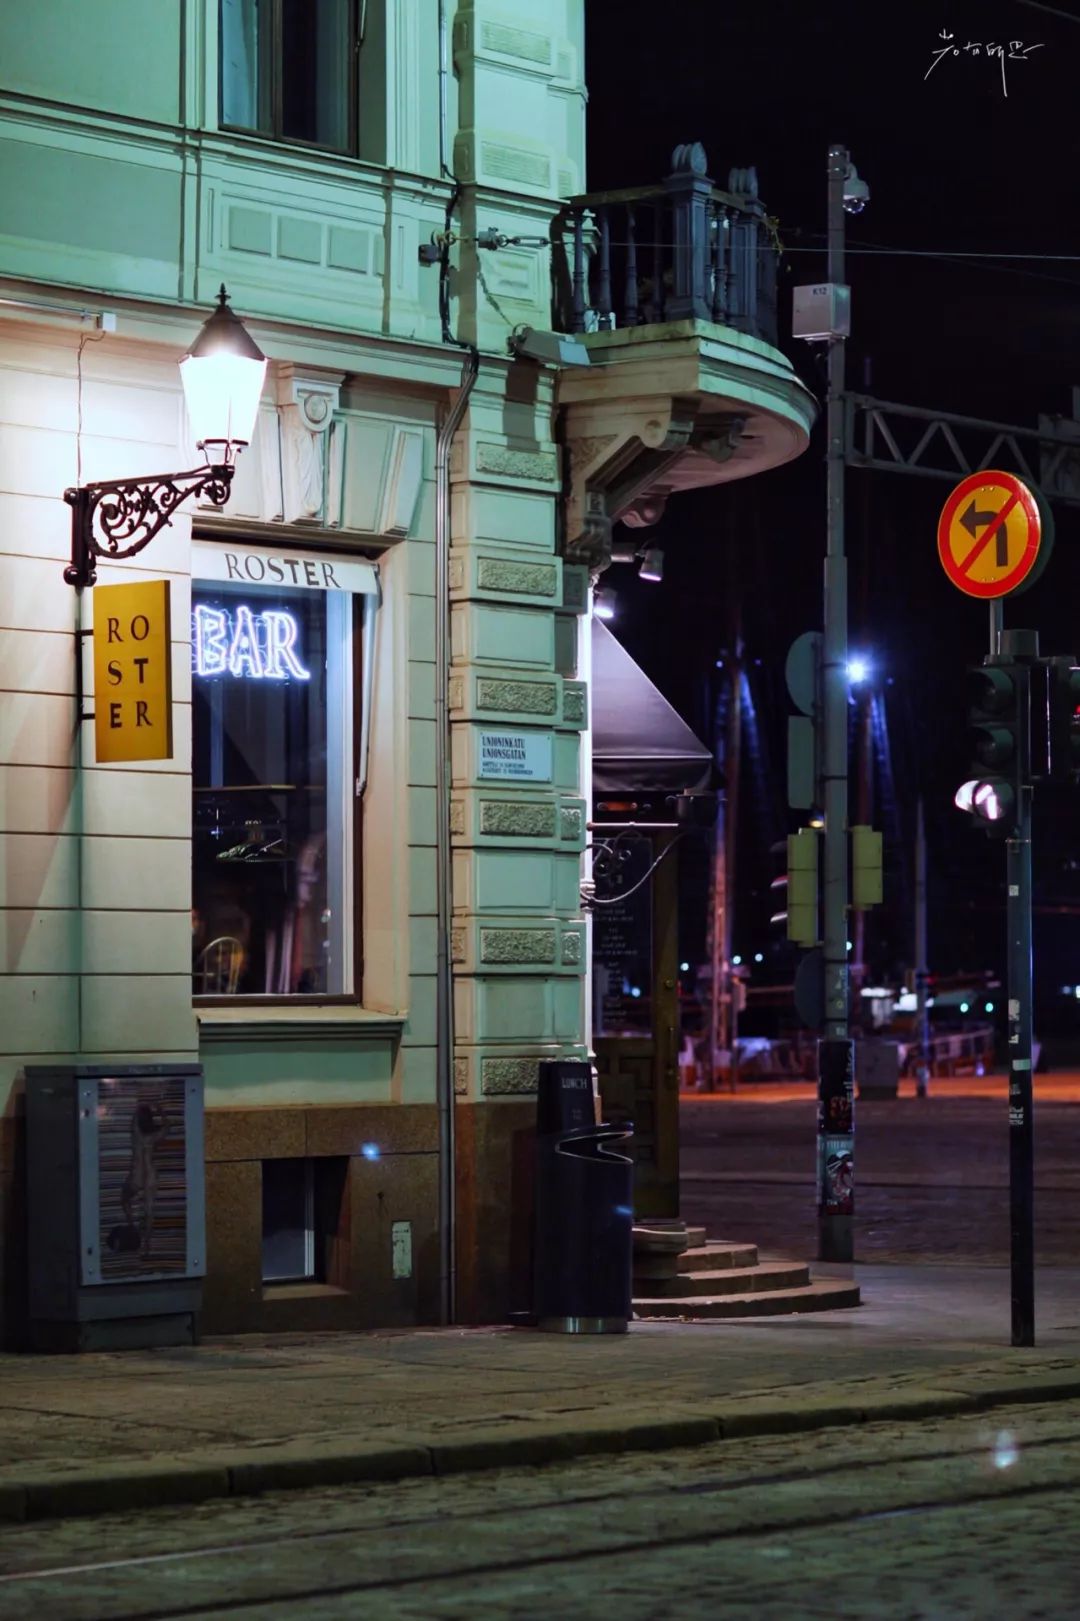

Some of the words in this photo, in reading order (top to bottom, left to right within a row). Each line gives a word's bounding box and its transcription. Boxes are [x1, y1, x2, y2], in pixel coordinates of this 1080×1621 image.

[224, 553, 341, 588] ROSTER
[194, 604, 311, 680] BAR
[482, 736, 526, 749] UNIONINKATU
[482, 748, 526, 760] UNIONSGATAN
